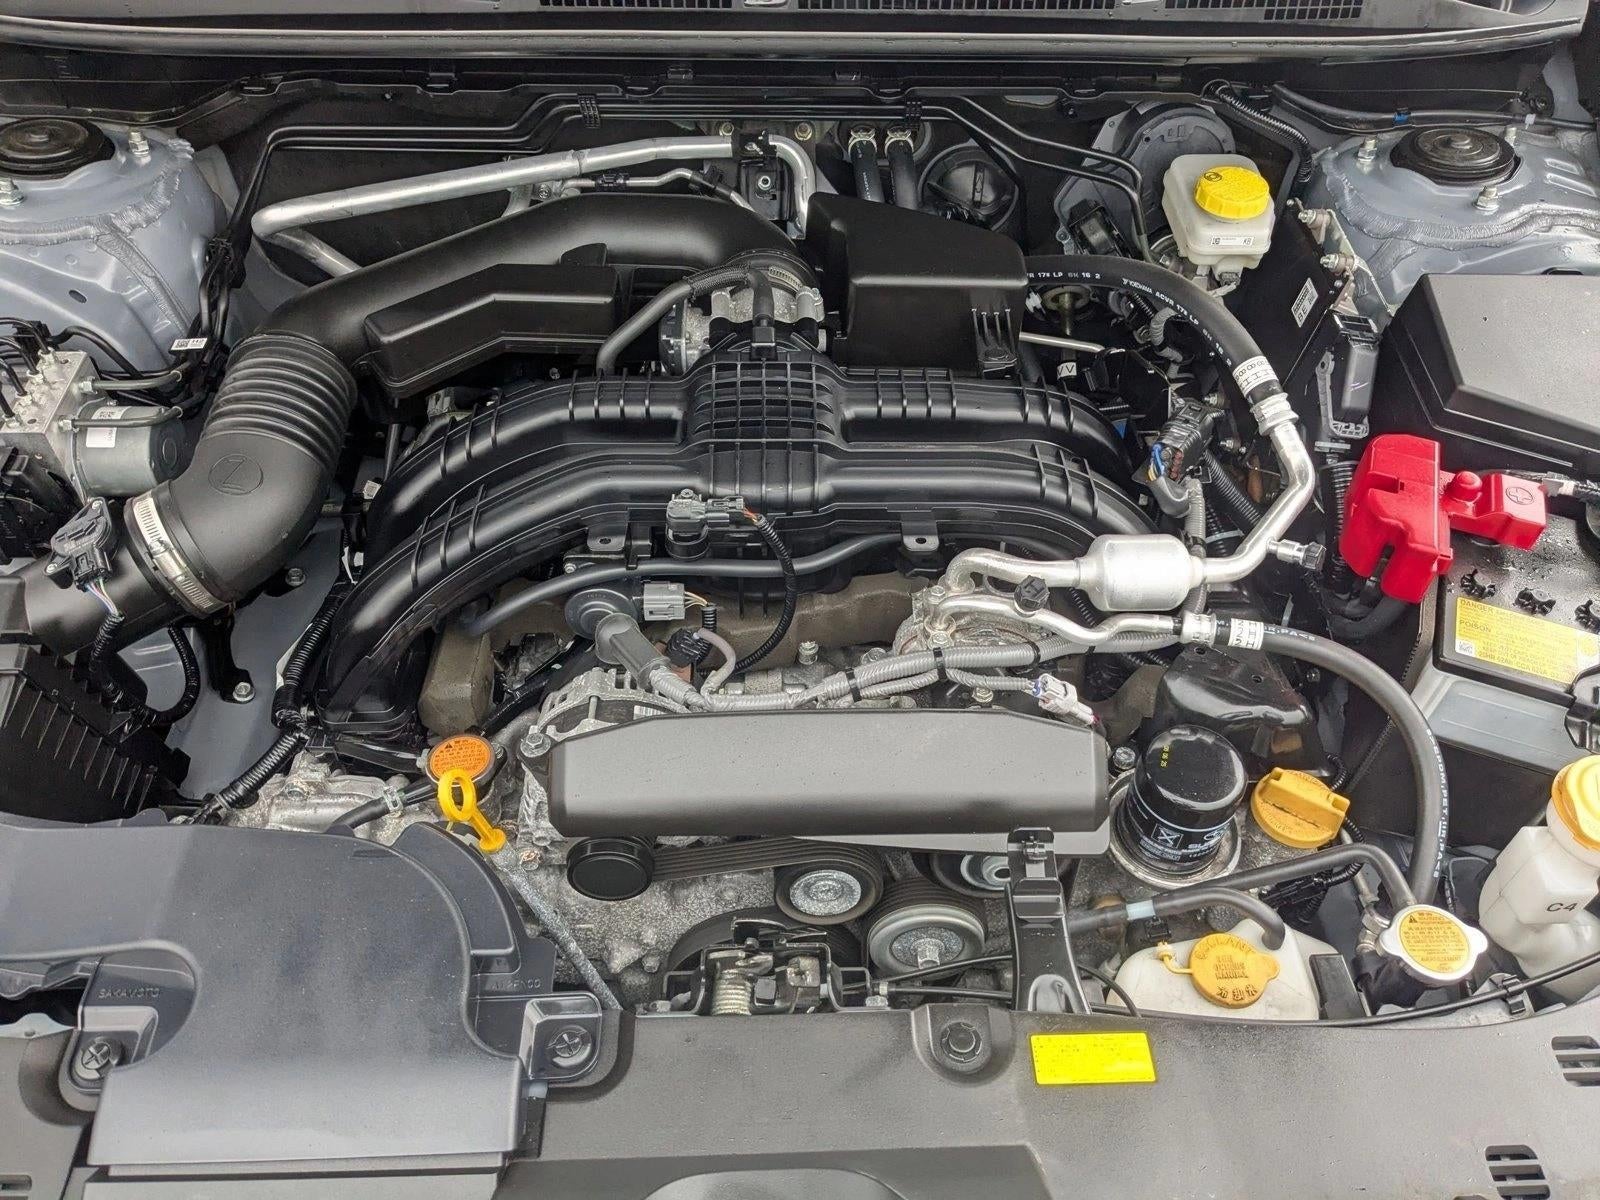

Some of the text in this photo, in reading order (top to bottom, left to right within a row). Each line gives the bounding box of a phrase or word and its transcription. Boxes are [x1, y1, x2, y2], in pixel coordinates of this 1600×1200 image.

[1460, 599, 1494, 614] DANGER
[1459, 619, 1492, 633] POISON
[1546, 902, 1578, 912] C4
